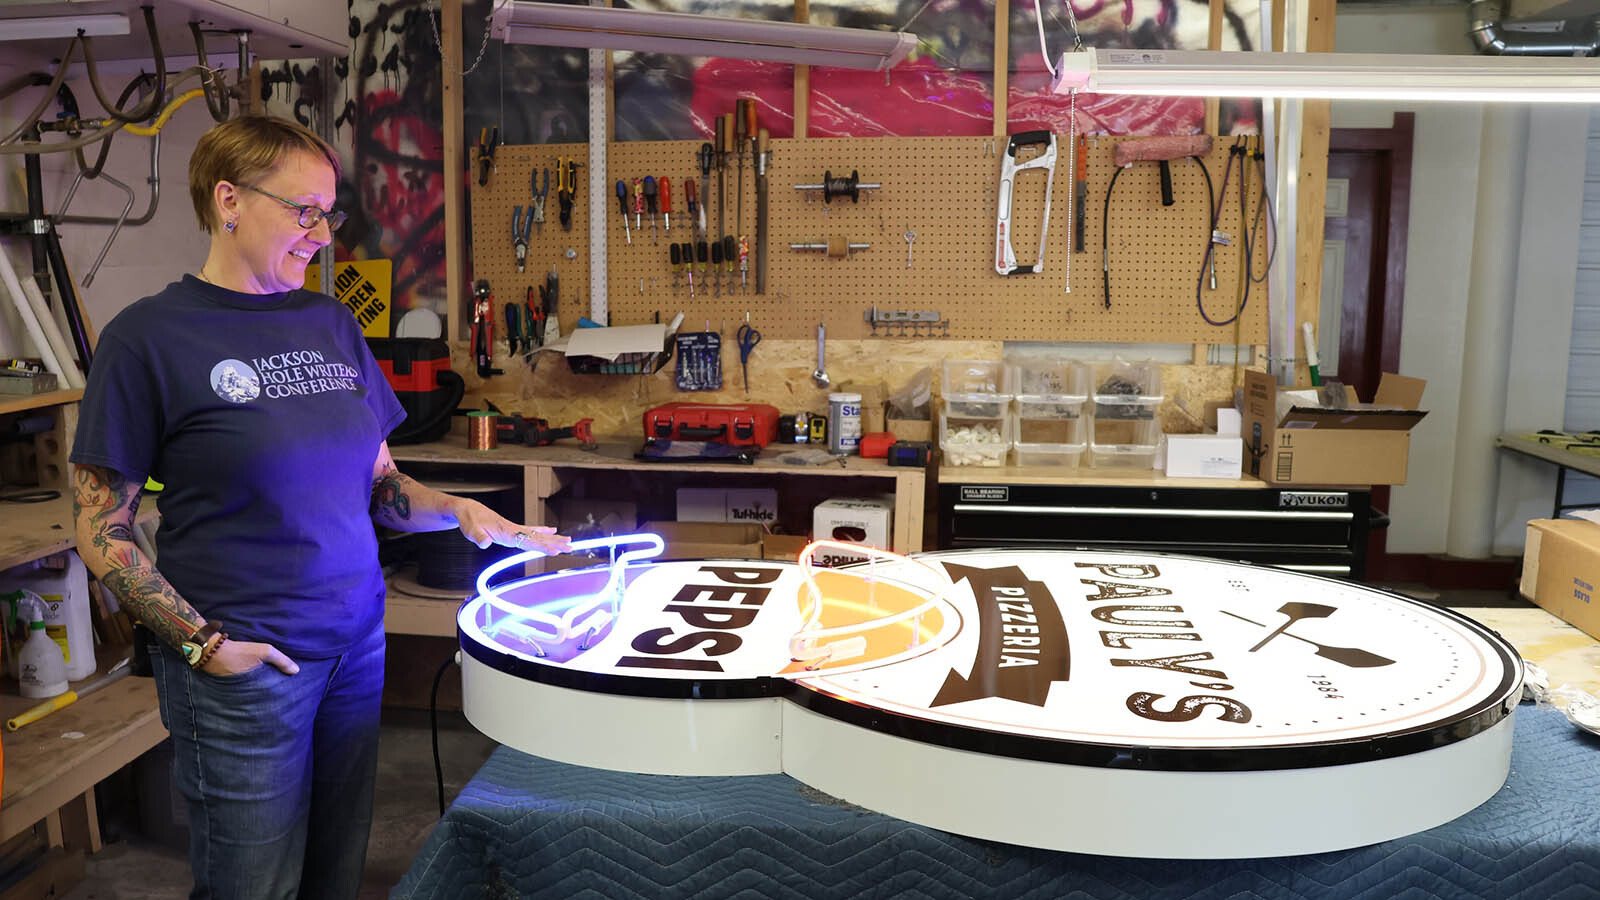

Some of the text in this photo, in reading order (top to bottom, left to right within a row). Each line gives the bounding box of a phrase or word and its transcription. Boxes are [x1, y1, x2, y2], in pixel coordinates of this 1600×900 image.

[335, 264, 360, 298] ION
[253, 350, 325, 374] JACKSON
[260, 367, 305, 385] HOLE
[265, 378, 357, 399] CONFERENCE
[1297, 496, 1346, 505] YUKON
[614, 566, 784, 673] PEPSI
[991, 586, 1041, 668] PIZZERIA
[1074, 562, 1252, 724] PAULY'S
[1306, 674, 1345, 699] 1984
